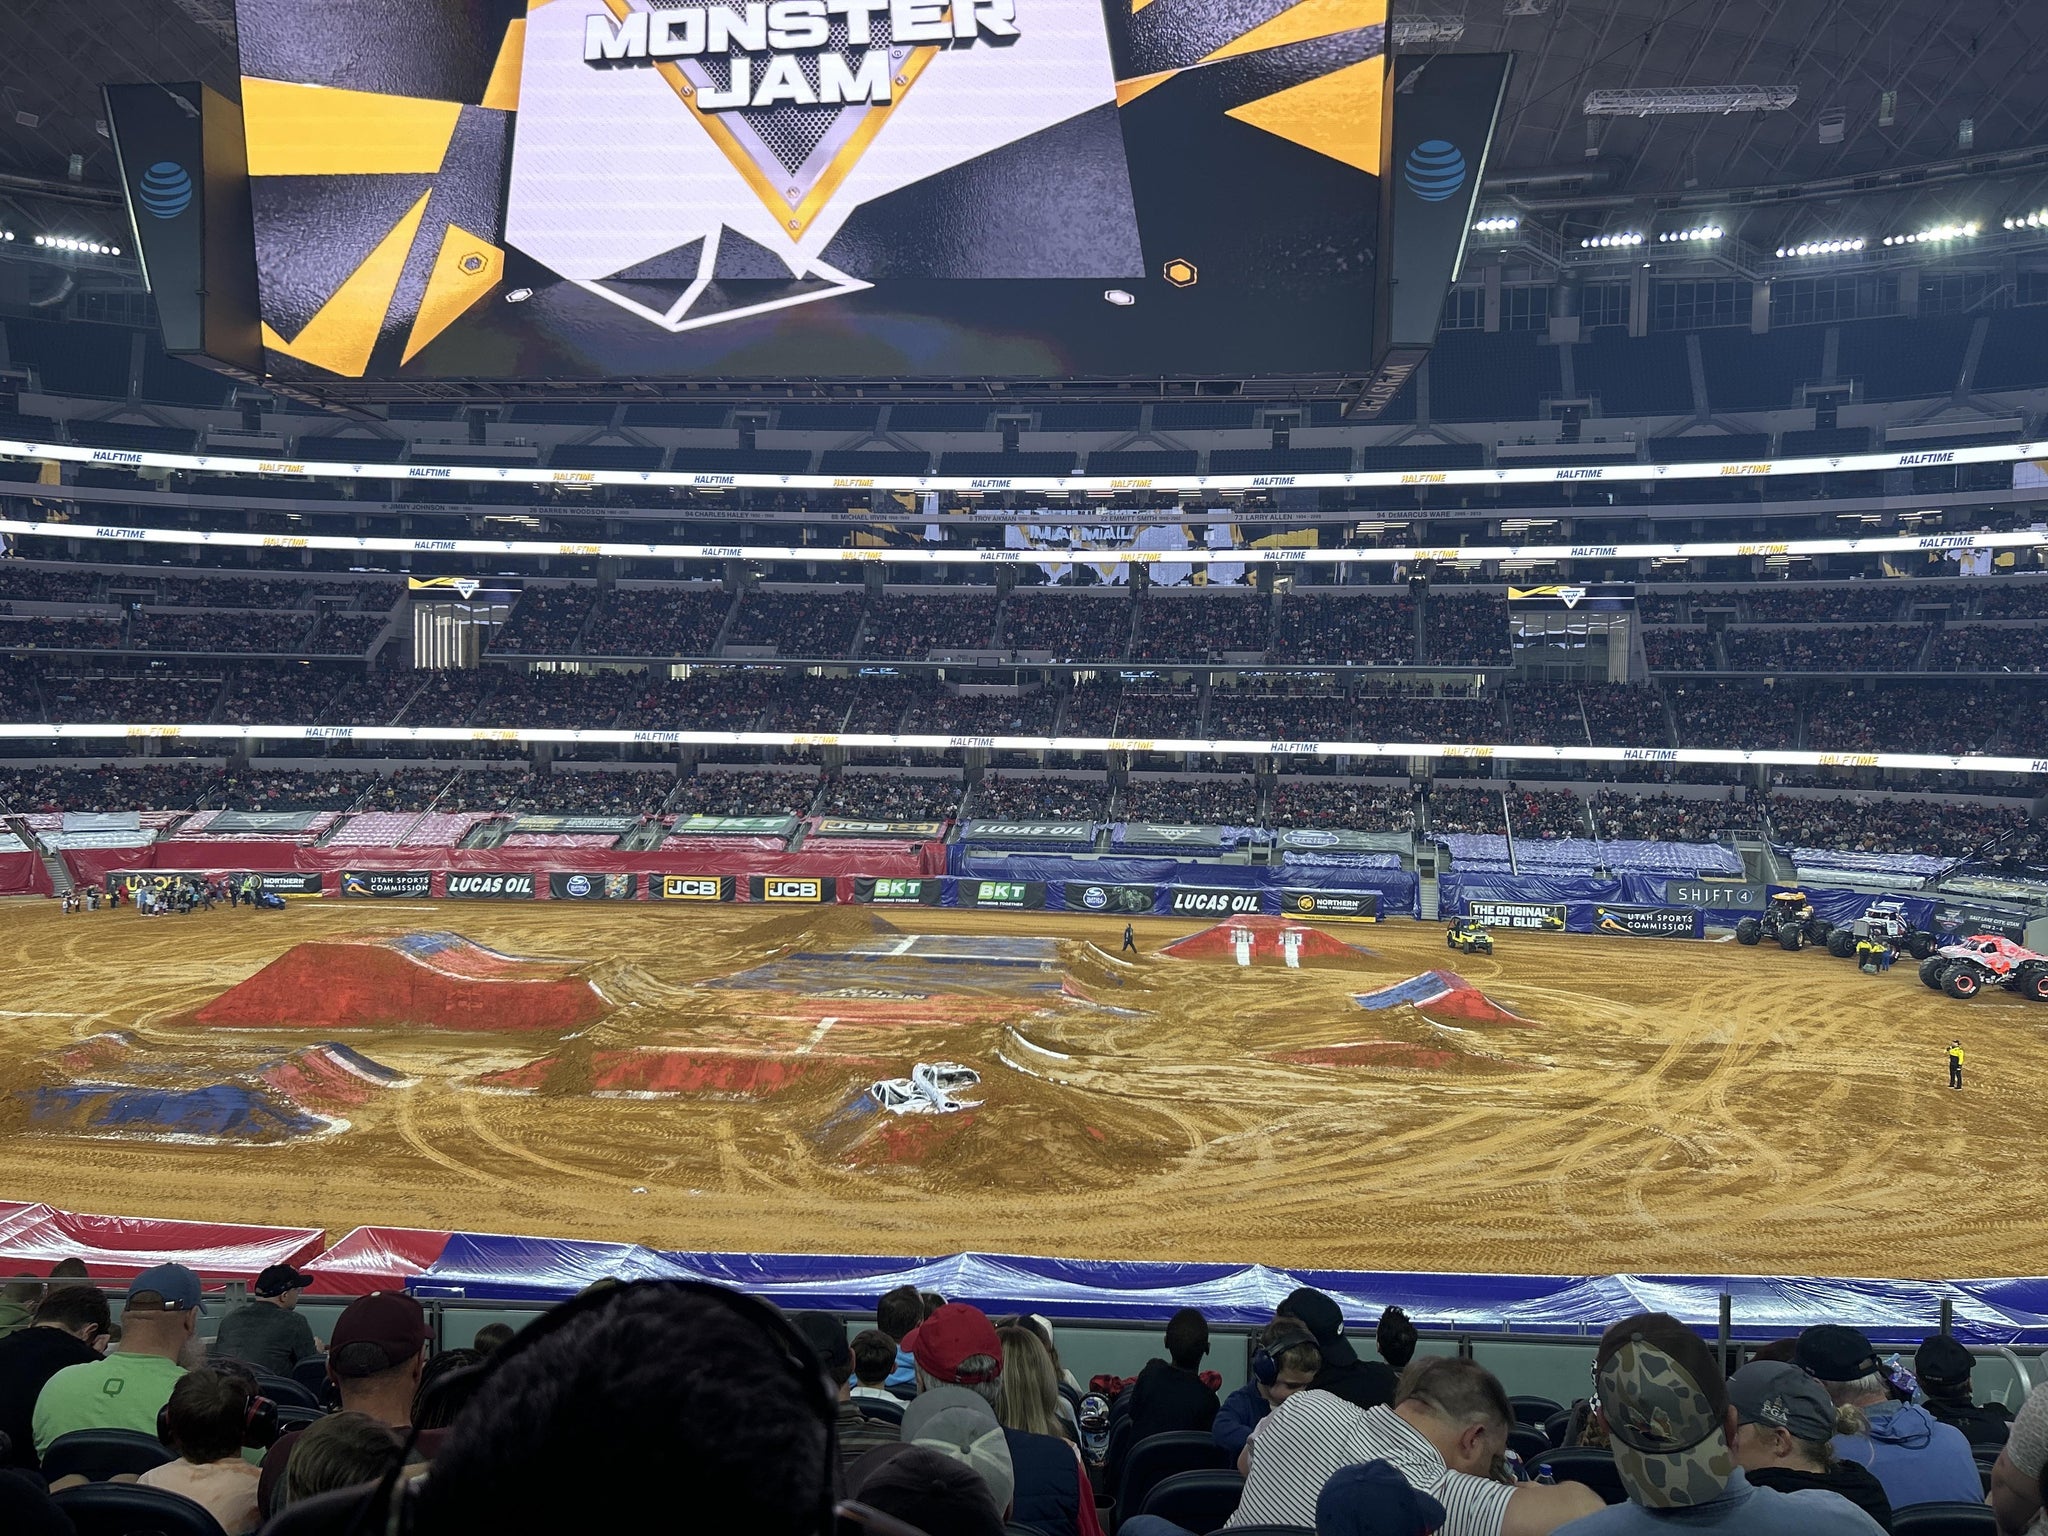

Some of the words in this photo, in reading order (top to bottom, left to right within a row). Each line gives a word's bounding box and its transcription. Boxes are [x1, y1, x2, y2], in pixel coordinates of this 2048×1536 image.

[584, 0, 1021, 68] MONSTER
[696, 50, 893, 109] JAM
[93, 451, 142, 463] HALFTIME
[1899, 452, 1955, 465] HALFTIME
[258, 463, 305, 473] HALFTIME
[409, 468, 451, 477] HALFTIME
[1720, 464, 1772, 475] HALFTIME
[553, 472, 595, 482] HALFTIME
[1401, 474, 1447, 483] HALFTIME
[1556, 469, 1603, 479] HALFTIME
[694, 475, 734, 484] HALFTIME
[833, 478, 874, 487] HALFTIME
[971, 479, 1012, 488] HALFTIME
[1111, 479, 1152, 488] HALFTIME
[1253, 477, 1295, 486] HALFTIME
[96, 527, 145, 539] HALFTIME
[263, 537, 309, 548] HALFTIME
[414, 541, 456, 550] HALFTIME
[1919, 536, 1975, 548] HALFTIME
[559, 545, 602, 555] HALFTIME
[701, 547, 742, 556] HALFTIME
[1414, 550, 1459, 559] HALFTIME
[1570, 547, 1617, 556] HALFTIME
[1737, 544, 1789, 555] HALFTIME
[841, 551, 883, 560] HALFTIME
[980, 552, 1020, 560] HALFTIME
[1120, 553, 1162, 561] HALFTIME
[1264, 551, 1306, 560] HALFTIME
[305, 727, 354, 737] HALFTIME
[634, 732, 680, 741] HALFTIME
[950, 737, 995, 746] HALFTIME
[1270, 743, 1319, 752] HALFTIME
[1623, 749, 1678, 760] HALFTIME
[826, 821, 889, 831] JCB
[974, 824, 1046, 835] LUCAS
[1049, 826, 1084, 836] OIL
[396, 876, 429, 884] SPORTS
[449, 877, 503, 892] LUCAS
[668, 880, 716, 895] JCB
[769, 882, 817, 897] JCB
[875, 881, 921, 894] BKT
[979, 884, 1025, 897] BKT
[1678, 888, 1734, 902] SHIFT
[1174, 893, 1228, 910] LUCAS
[1316, 899, 1359, 907] NORTHERN
[1472, 905, 1495, 914] THE
[1496, 905, 1549, 917] ORIGINAL
[1513, 917, 1542, 928] GLUE
[1627, 913, 1653, 921] UTAH
[1657, 915, 1693, 923] SPORTS
[1627, 921, 1692, 931] COMMISSION
[103, 1378, 124, 1398] Q
[1761, 1403, 1788, 1421] PGA
